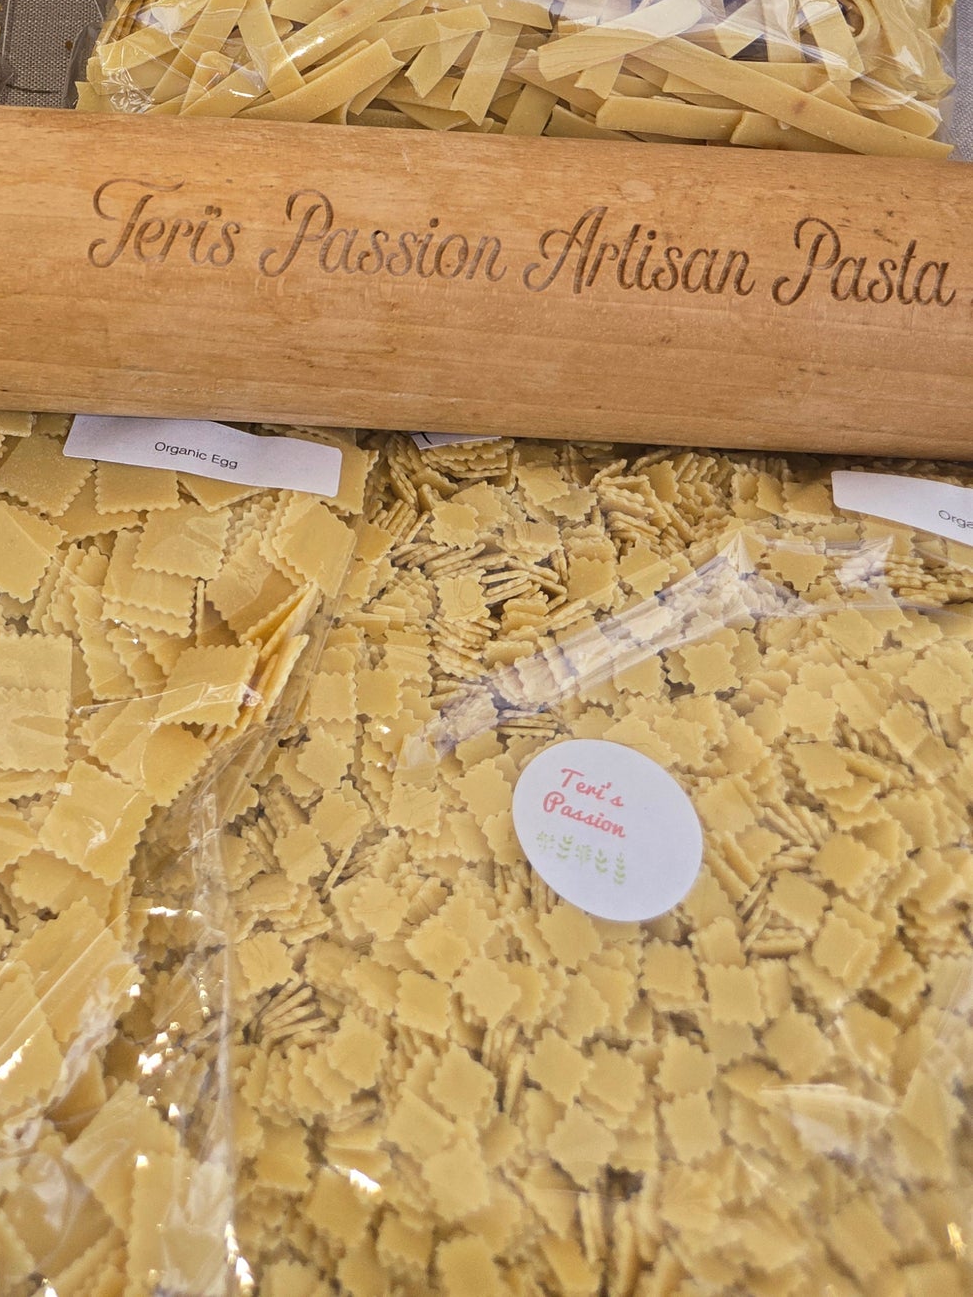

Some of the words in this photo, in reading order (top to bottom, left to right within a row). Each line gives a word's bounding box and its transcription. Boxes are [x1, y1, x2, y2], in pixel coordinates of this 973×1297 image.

[88, 177, 243, 269] Teri's
[258, 188, 508, 282] Passion
[522, 205, 756, 297] Artisan
[771, 216, 957, 307] Pasta
[154, 441, 207, 461] Organic
[211, 453, 239, 471] Egg
[561, 767, 624, 807] Teri's
[542, 790, 627, 838] Passion
